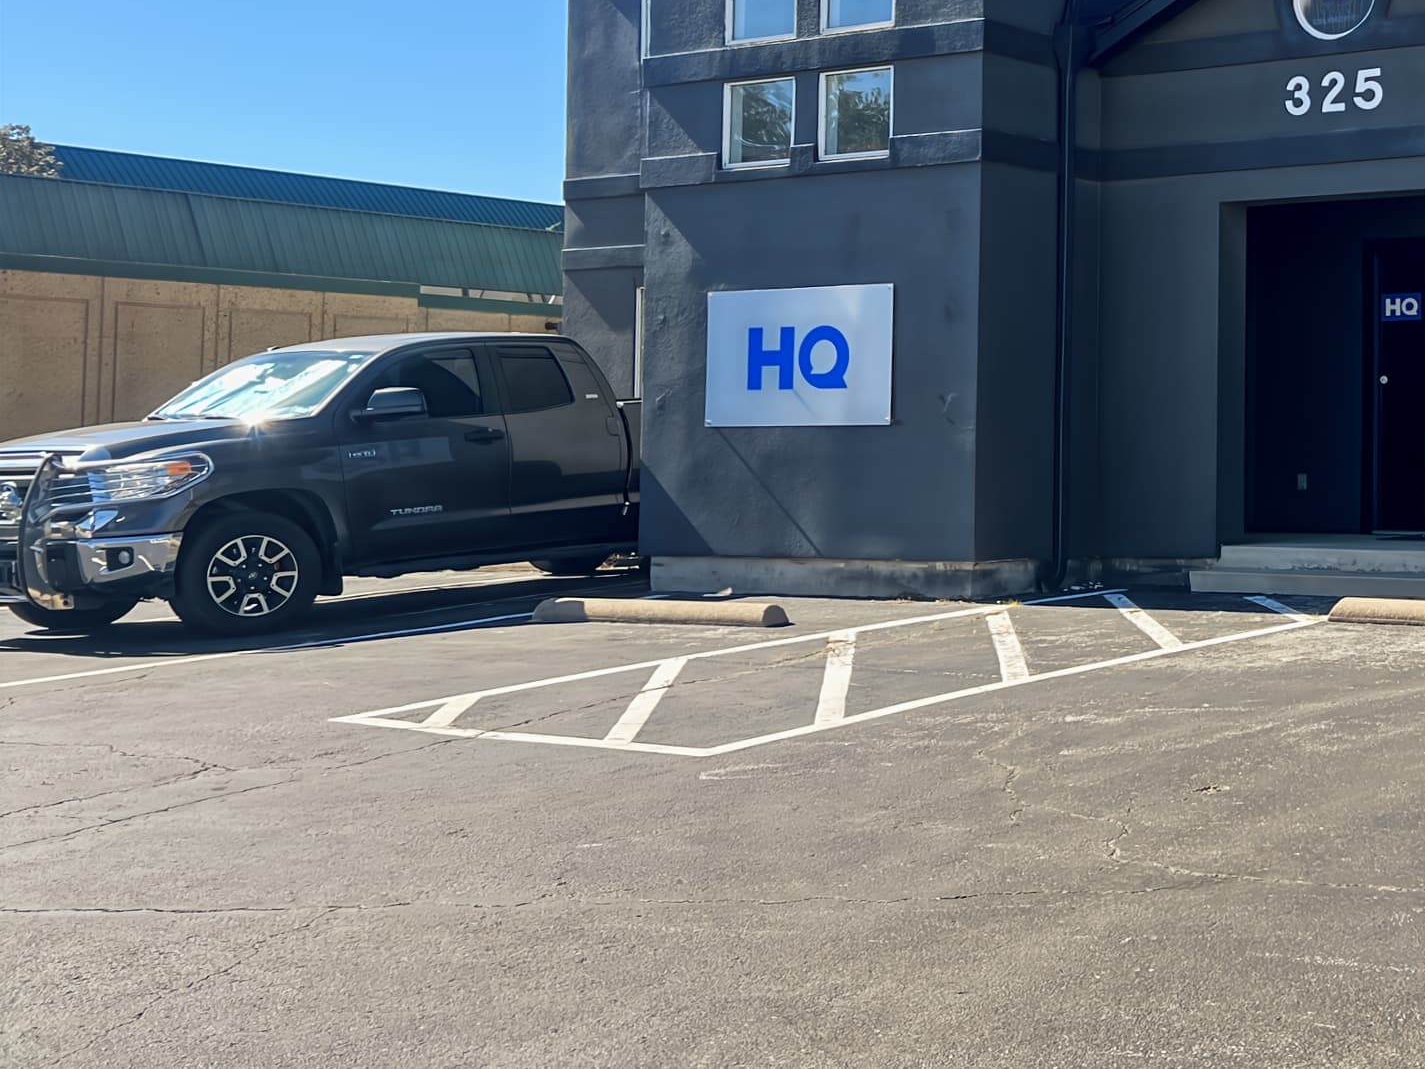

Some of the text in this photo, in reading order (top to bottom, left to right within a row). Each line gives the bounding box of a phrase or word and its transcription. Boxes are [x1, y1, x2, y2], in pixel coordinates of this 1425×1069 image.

[1284, 67, 1383, 116] 325
[1385, 297, 1418, 316] HQ
[747, 325, 850, 391] HQ
[390, 505, 443, 516] TUNDRA
